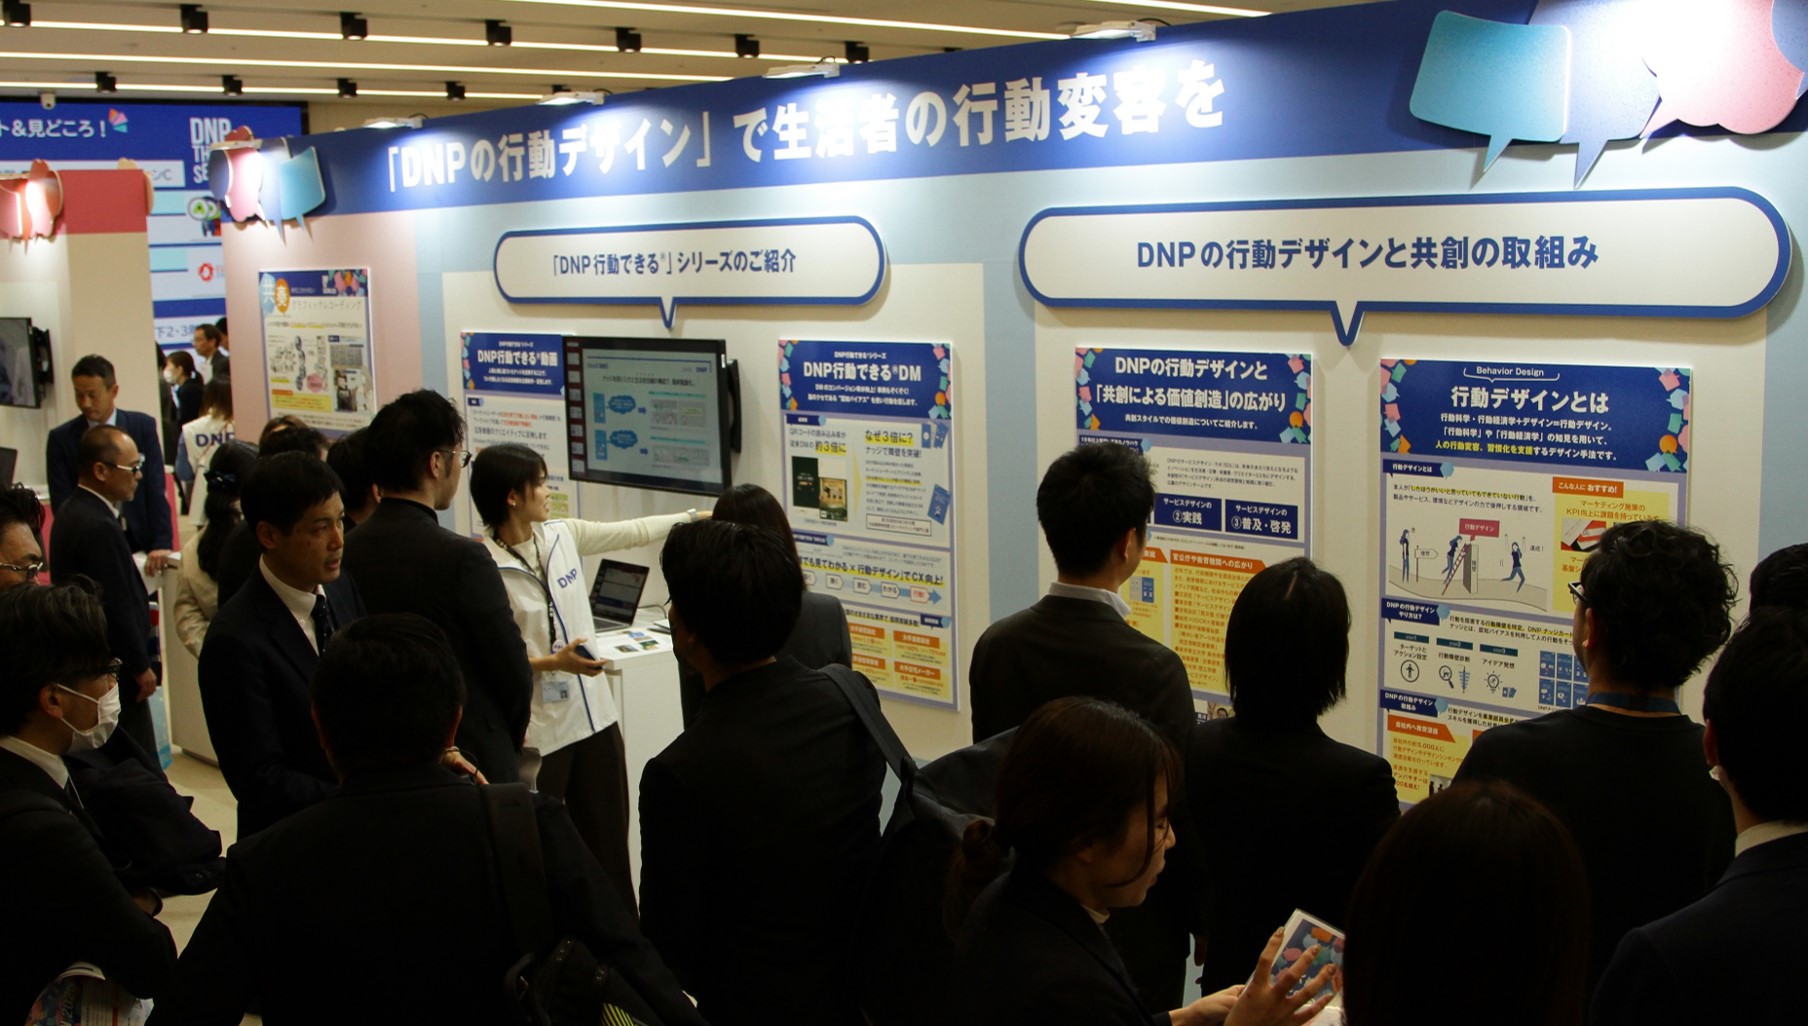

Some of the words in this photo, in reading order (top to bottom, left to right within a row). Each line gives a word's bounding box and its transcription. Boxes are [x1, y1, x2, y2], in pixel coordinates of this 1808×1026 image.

[388, 60, 1224, 192] 「DNPの行動デザイン」で生活者の行動変容を
[1136, 234, 1599, 270] DNPの行動デザインと共創の取組み
[1115, 357, 1268, 381] DNPの行動デザインと
[1476, 366, 1513, 376] Behavior
[1516, 367, 1544, 377] Design
[1096, 385, 1286, 412] 「共創による価値創造」の広がり
[1451, 385, 1609, 414] 行動デザインとは
[1435, 440, 1617, 462] 人の行動変容、習慣化を支援するデザイン手法です。
[1392, 463, 1433, 473] 行動デザインとは
[1558, 481, 1586, 492] こんな人に
[1163, 498, 1213, 509] サービスデザインの
[1235, 504, 1288, 516] サービスデザインの
[1464, 524, 1495, 533] 行動デザイン
[1172, 552, 1253, 569] 官公庁や教育機関への広がり
[556, 568, 578, 589] DNP
[1386, 601, 1435, 614] DNPの行動デザイン
[1482, 658, 1515, 669] アイデア発想
[1384, 692, 1434, 706] DNPの行動デザイン
